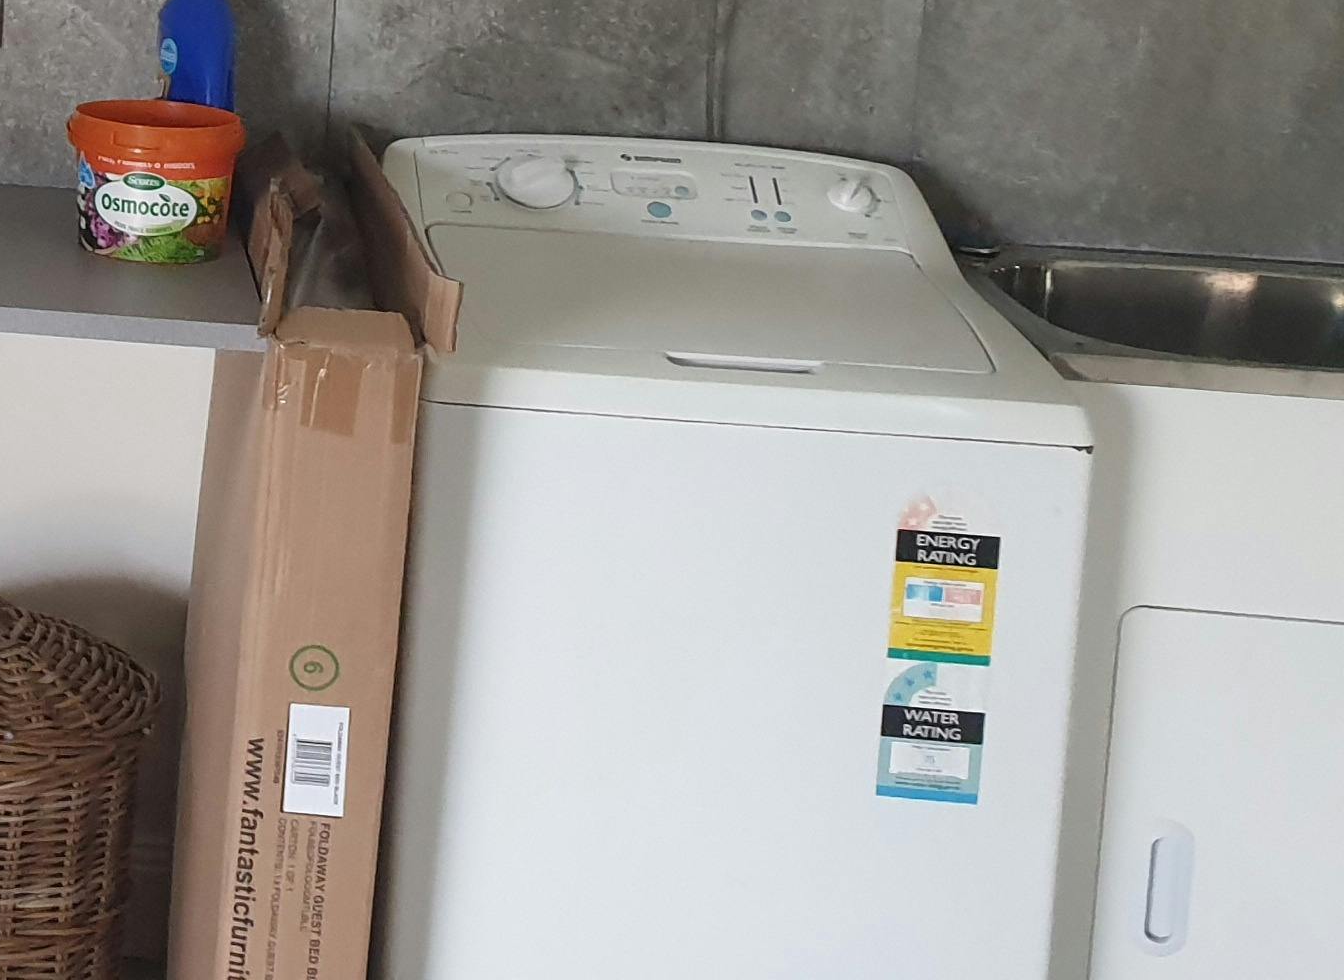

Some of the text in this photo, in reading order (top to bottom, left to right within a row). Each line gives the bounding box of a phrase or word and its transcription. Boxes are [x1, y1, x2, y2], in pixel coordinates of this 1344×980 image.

[916, 534, 981, 550] ENERGY
[917, 549, 977, 565] RATING
[903, 709, 960, 725] WATER
[902, 723, 962, 740] RATING
[315, 822, 331, 892] FOLDAWAY
[311, 894, 325, 937] GUEST
[308, 939, 321, 965] BED
